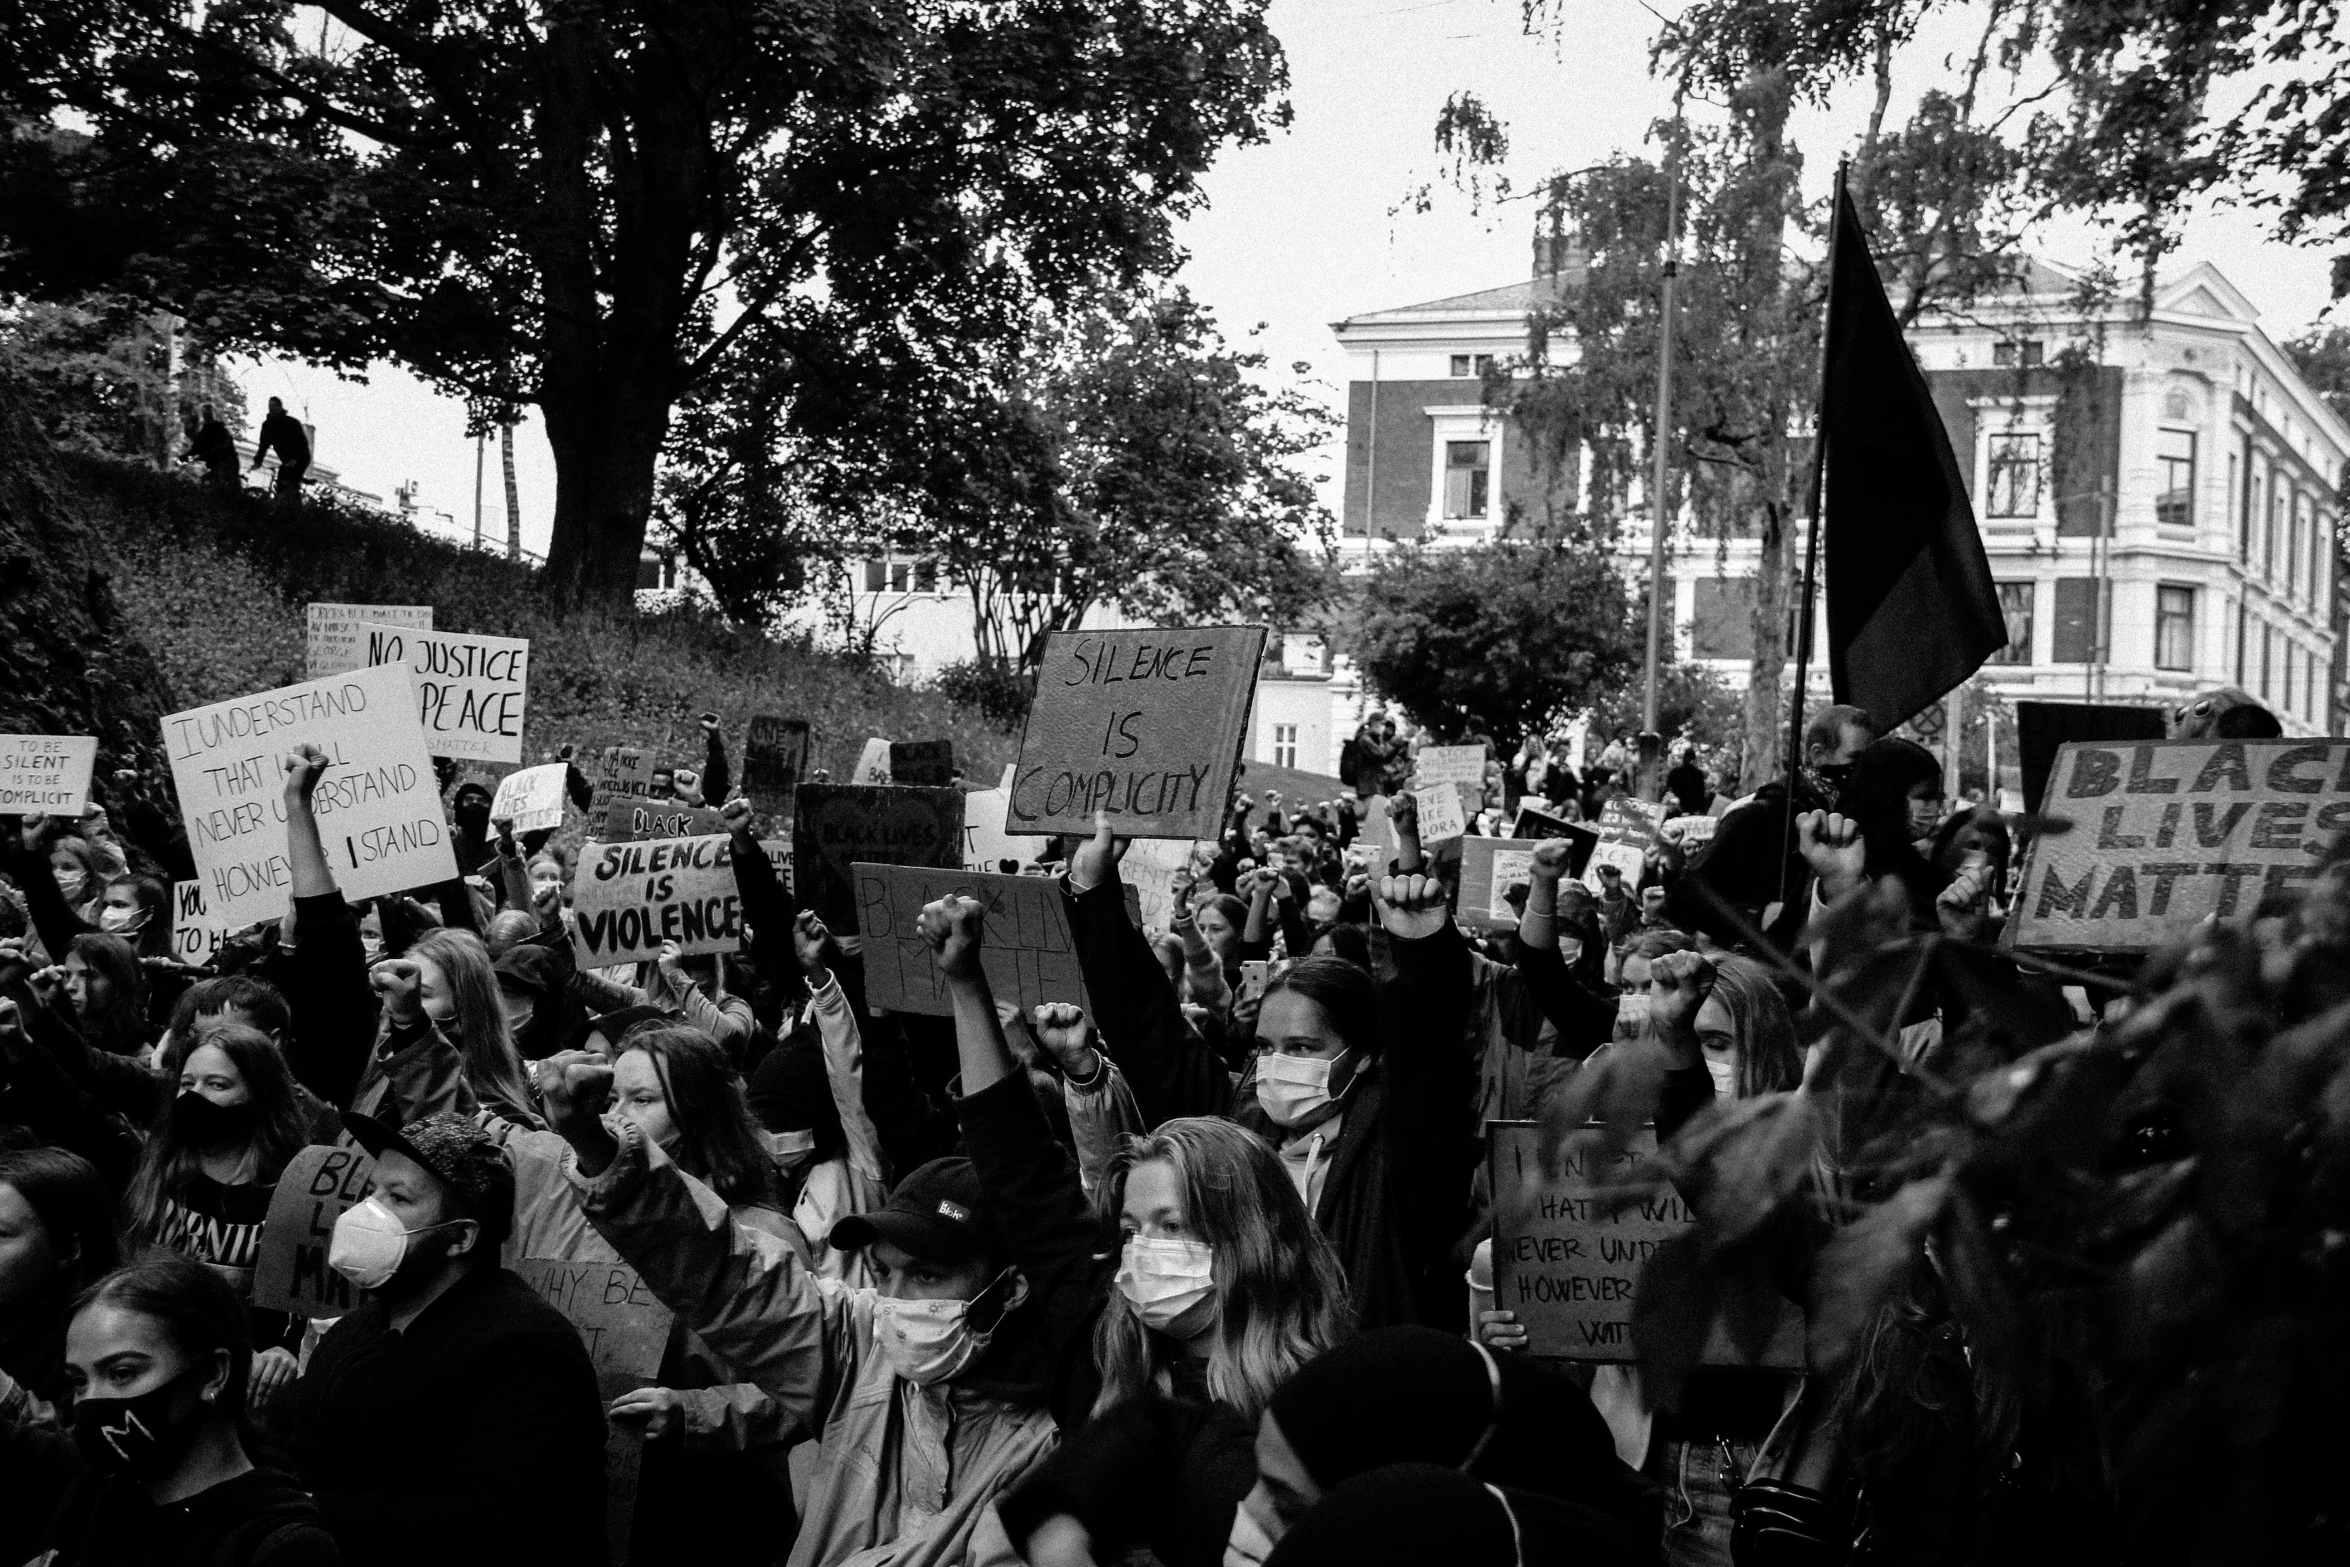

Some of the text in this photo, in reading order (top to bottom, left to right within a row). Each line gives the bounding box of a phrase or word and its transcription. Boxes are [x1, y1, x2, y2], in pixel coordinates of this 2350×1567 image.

[369, 632, 523, 682] NO JUSTICE
[1065, 638, 1213, 686] SILENCE
[171, 684, 366, 760] I UNDERSTAND
[420, 682, 522, 737] PEACE
[20, 740, 62, 753] TO BE
[1103, 711, 1142, 758] IS
[3, 755, 71, 769] SILENT
[12, 774, 60, 785] IS TO BE
[203, 755, 264, 797] THAT
[274, 753, 284, 781] I
[196, 764, 416, 848] NEVER UERSTAND
[1012, 764, 1211, 822] COMPLICITY
[347, 836, 358, 869] I
[362, 820, 439, 861] STAND
[634, 807, 693, 838] BLACK
[2097, 802, 2350, 854] LIVES
[595, 836, 732, 881] SILENCE
[179, 884, 207, 922] YOU
[646, 875, 673, 902] IS
[861, 877, 1008, 945] BLK
[176, 924, 202, 956] TO
[578, 895, 741, 956] VIOLENCE
[1512, 1236, 1587, 1262] EVER
[604, 1270, 651, 1306] BE
[1518, 1276, 1635, 1303] HOWEVER
